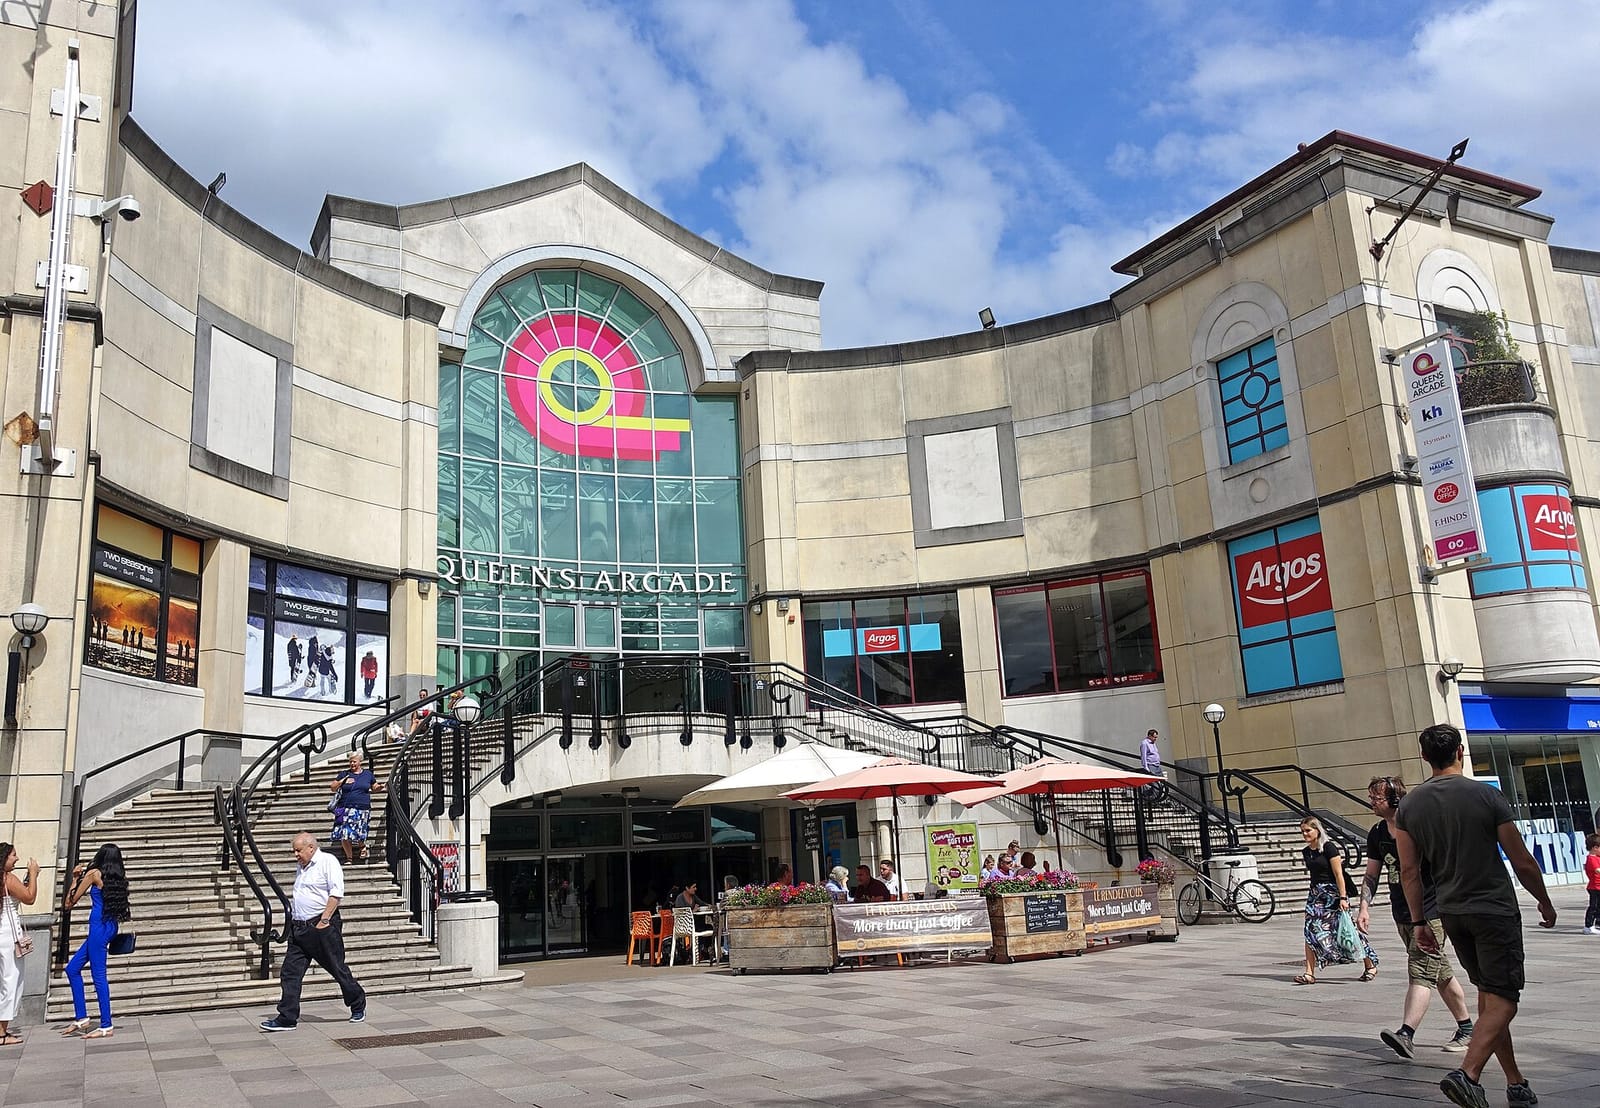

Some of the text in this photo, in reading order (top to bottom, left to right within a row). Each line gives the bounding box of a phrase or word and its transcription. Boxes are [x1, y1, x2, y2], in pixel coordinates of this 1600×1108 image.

[1411, 371, 1444, 389] QUEENS
[1413, 379, 1446, 398] ARCADE
[1422, 405, 1443, 422] kh
[1429, 459, 1455, 471] HALIFAX
[1436, 490, 1457, 501] OFFICE
[1438, 485, 1453, 495] POST
[1534, 504, 1575, 529] Argo
[104, 551, 120, 562] TWO
[436, 555, 738, 593] QUEENS ARCADE
[1245, 552, 1322, 592] Argos
[284, 601, 302, 610] TWO
[867, 633, 897, 645] Argos
[1534, 818, 1556, 834] YOU
[1521, 831, 1588, 875] XTRA
[1088, 899, 1152, 918] More than just Coffee
[852, 914, 974, 933] More than just Coffee
